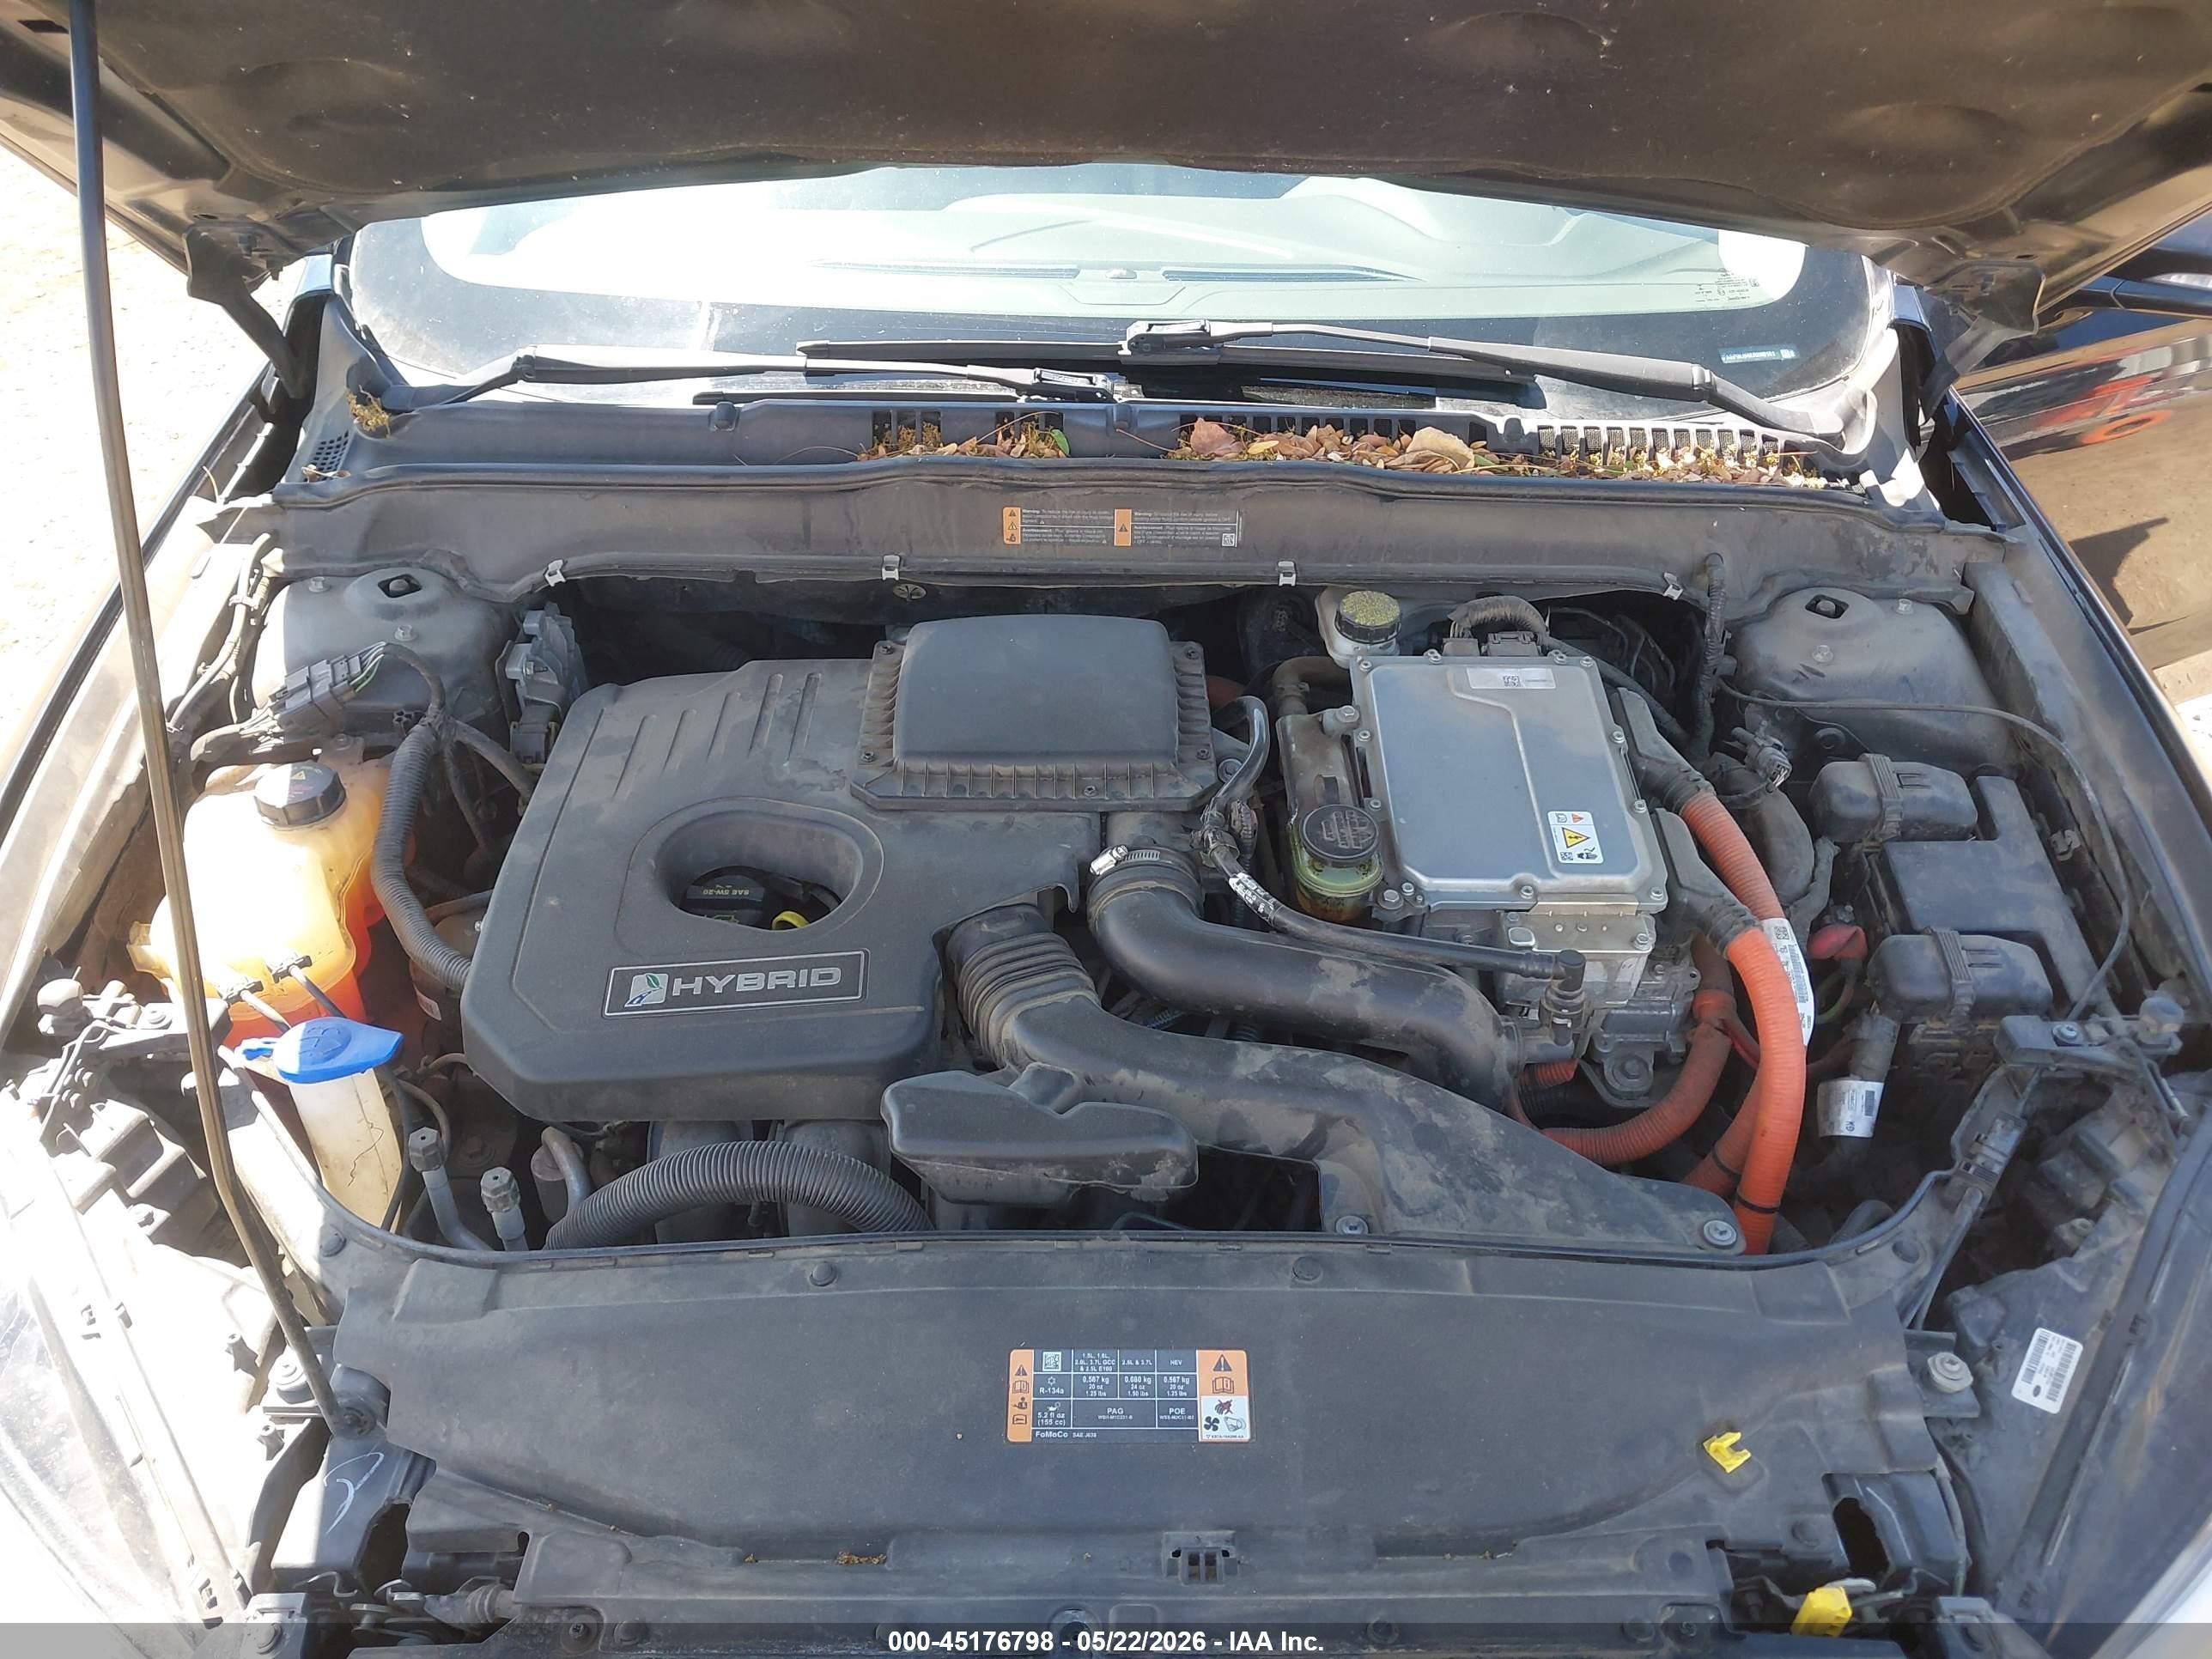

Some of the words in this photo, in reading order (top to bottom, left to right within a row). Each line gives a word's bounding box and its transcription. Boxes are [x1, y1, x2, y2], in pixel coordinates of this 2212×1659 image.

[672, 967, 842, 997] HYBRID
[1101, 1376, 1109, 1384] kg
[1143, 1376, 1152, 1384] kg
[1181, 1376, 1189, 1384] kg
